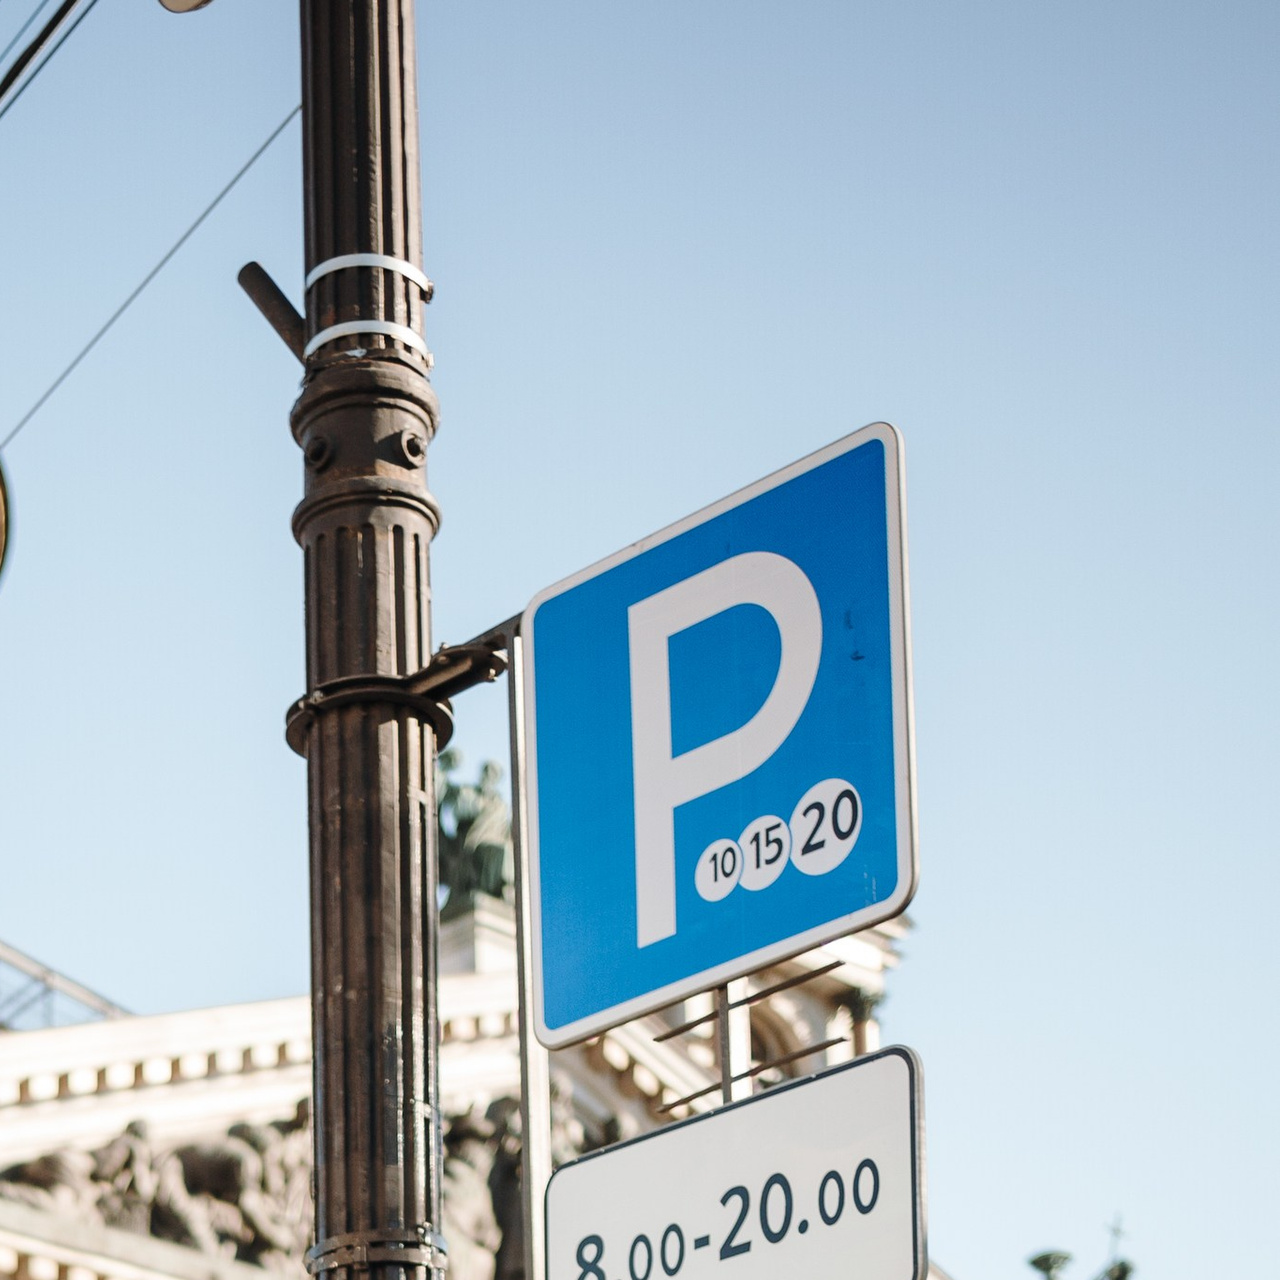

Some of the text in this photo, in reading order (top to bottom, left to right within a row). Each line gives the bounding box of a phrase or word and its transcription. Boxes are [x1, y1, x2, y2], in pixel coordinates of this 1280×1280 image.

[627, 551, 823, 950] P
[709, 788, 859, 882] 10 15 20
